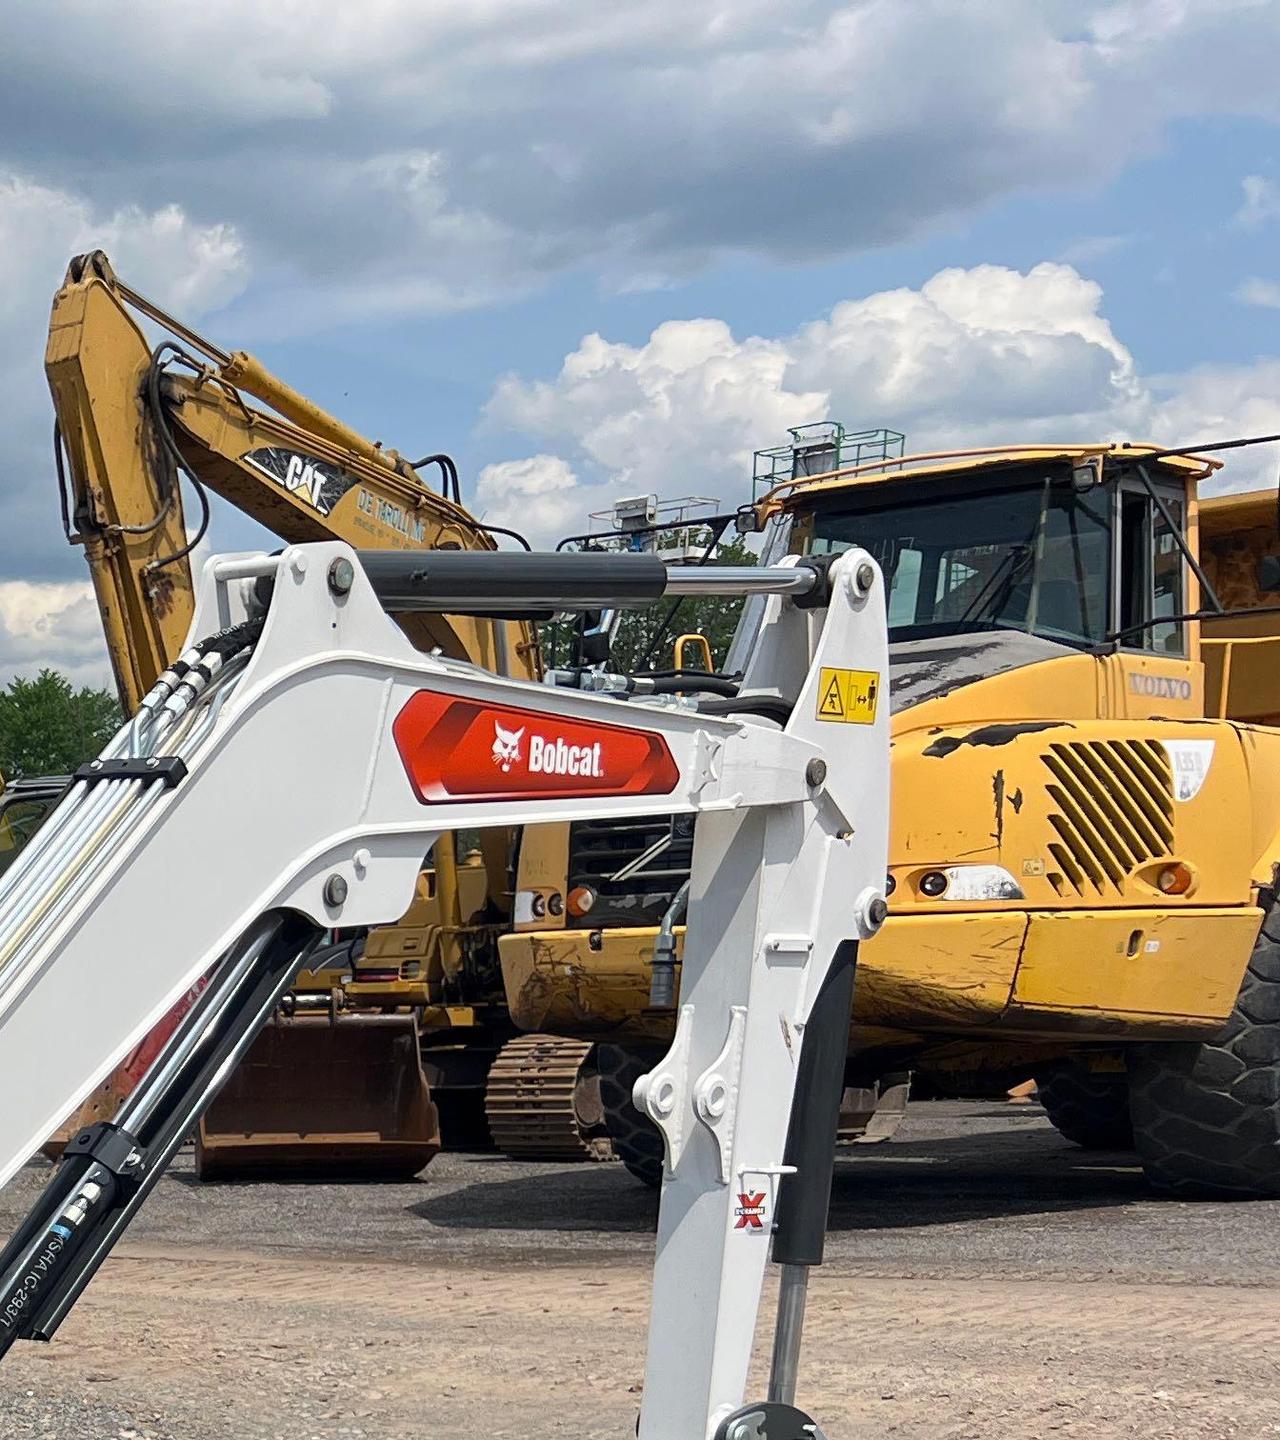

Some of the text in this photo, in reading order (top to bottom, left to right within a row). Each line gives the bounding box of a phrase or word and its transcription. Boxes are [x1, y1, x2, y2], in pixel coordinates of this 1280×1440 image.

[285, 455, 328, 508] CAT
[1128, 672, 1192, 700] VOLVO
[528, 735, 602, 778] Bobcat
